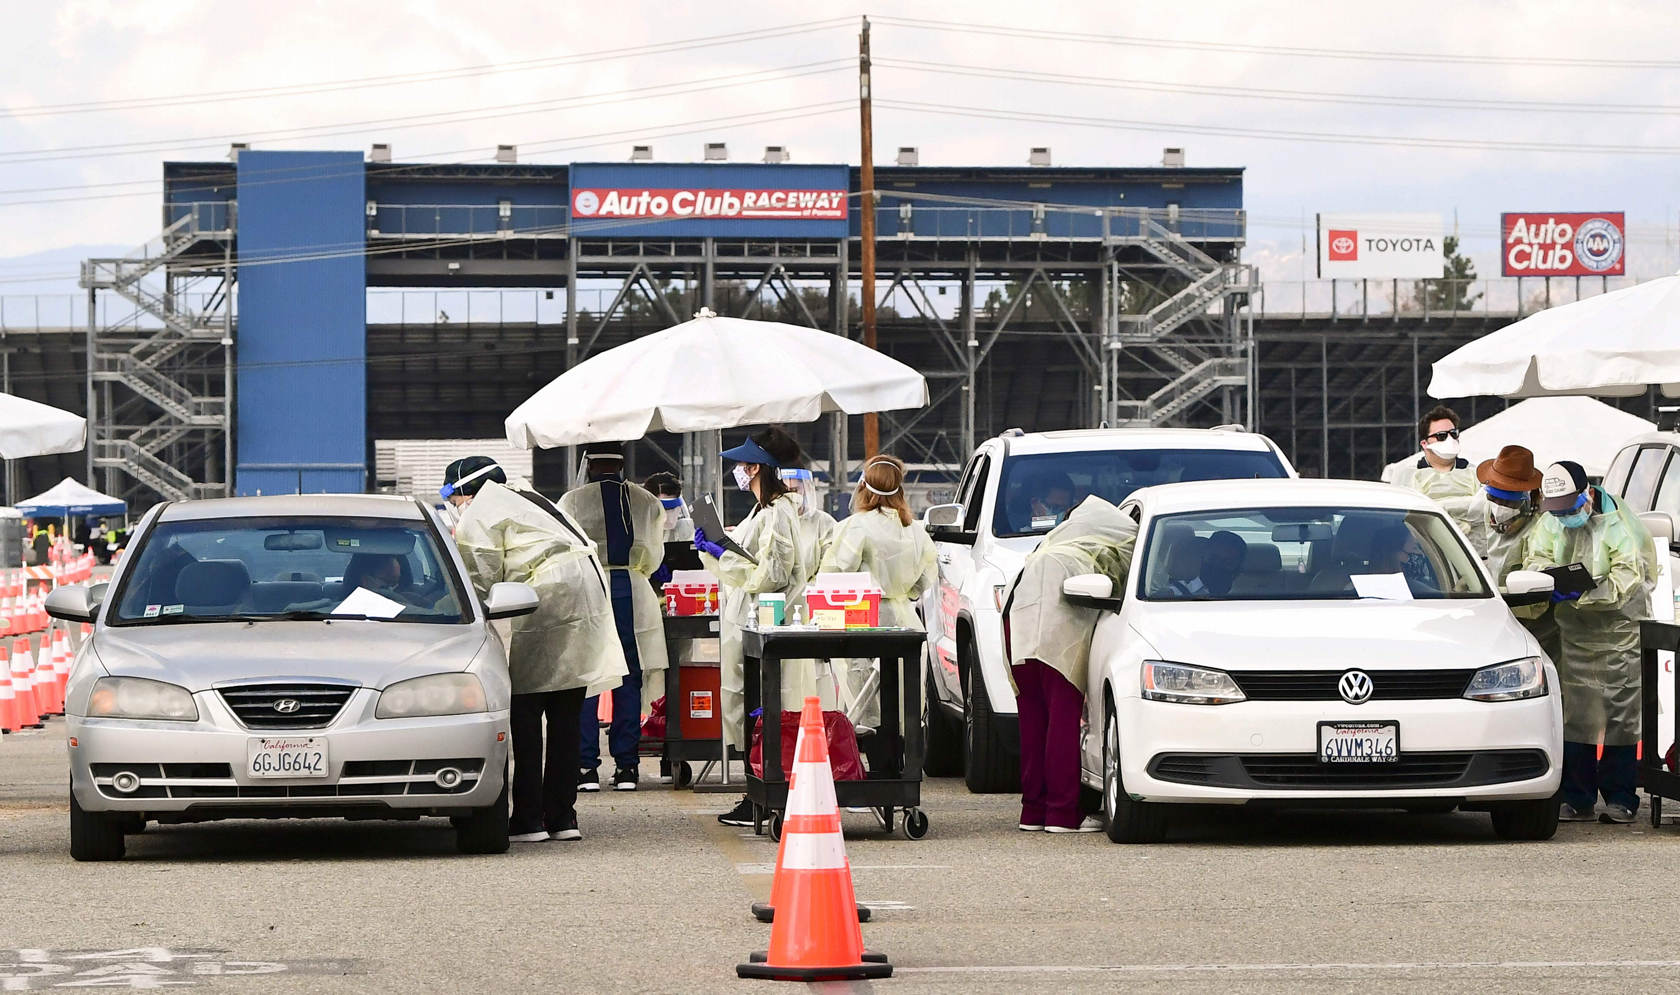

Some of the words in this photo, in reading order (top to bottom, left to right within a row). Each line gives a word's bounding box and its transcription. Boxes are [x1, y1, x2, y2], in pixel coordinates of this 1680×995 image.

[598, 190, 668, 216] Auto
[671, 190, 742, 216] Club
[742, 191, 842, 208] RACEWAY
[1508, 217, 1573, 245] Auto
[1365, 238, 1435, 252] TOYOTA
[1508, 243, 1573, 270] Club
[1336, 728, 1384, 738] California
[263, 739, 312, 752] California
[1325, 737, 1393, 758] 6VVM346
[252, 752, 322, 772] 6GJG642
